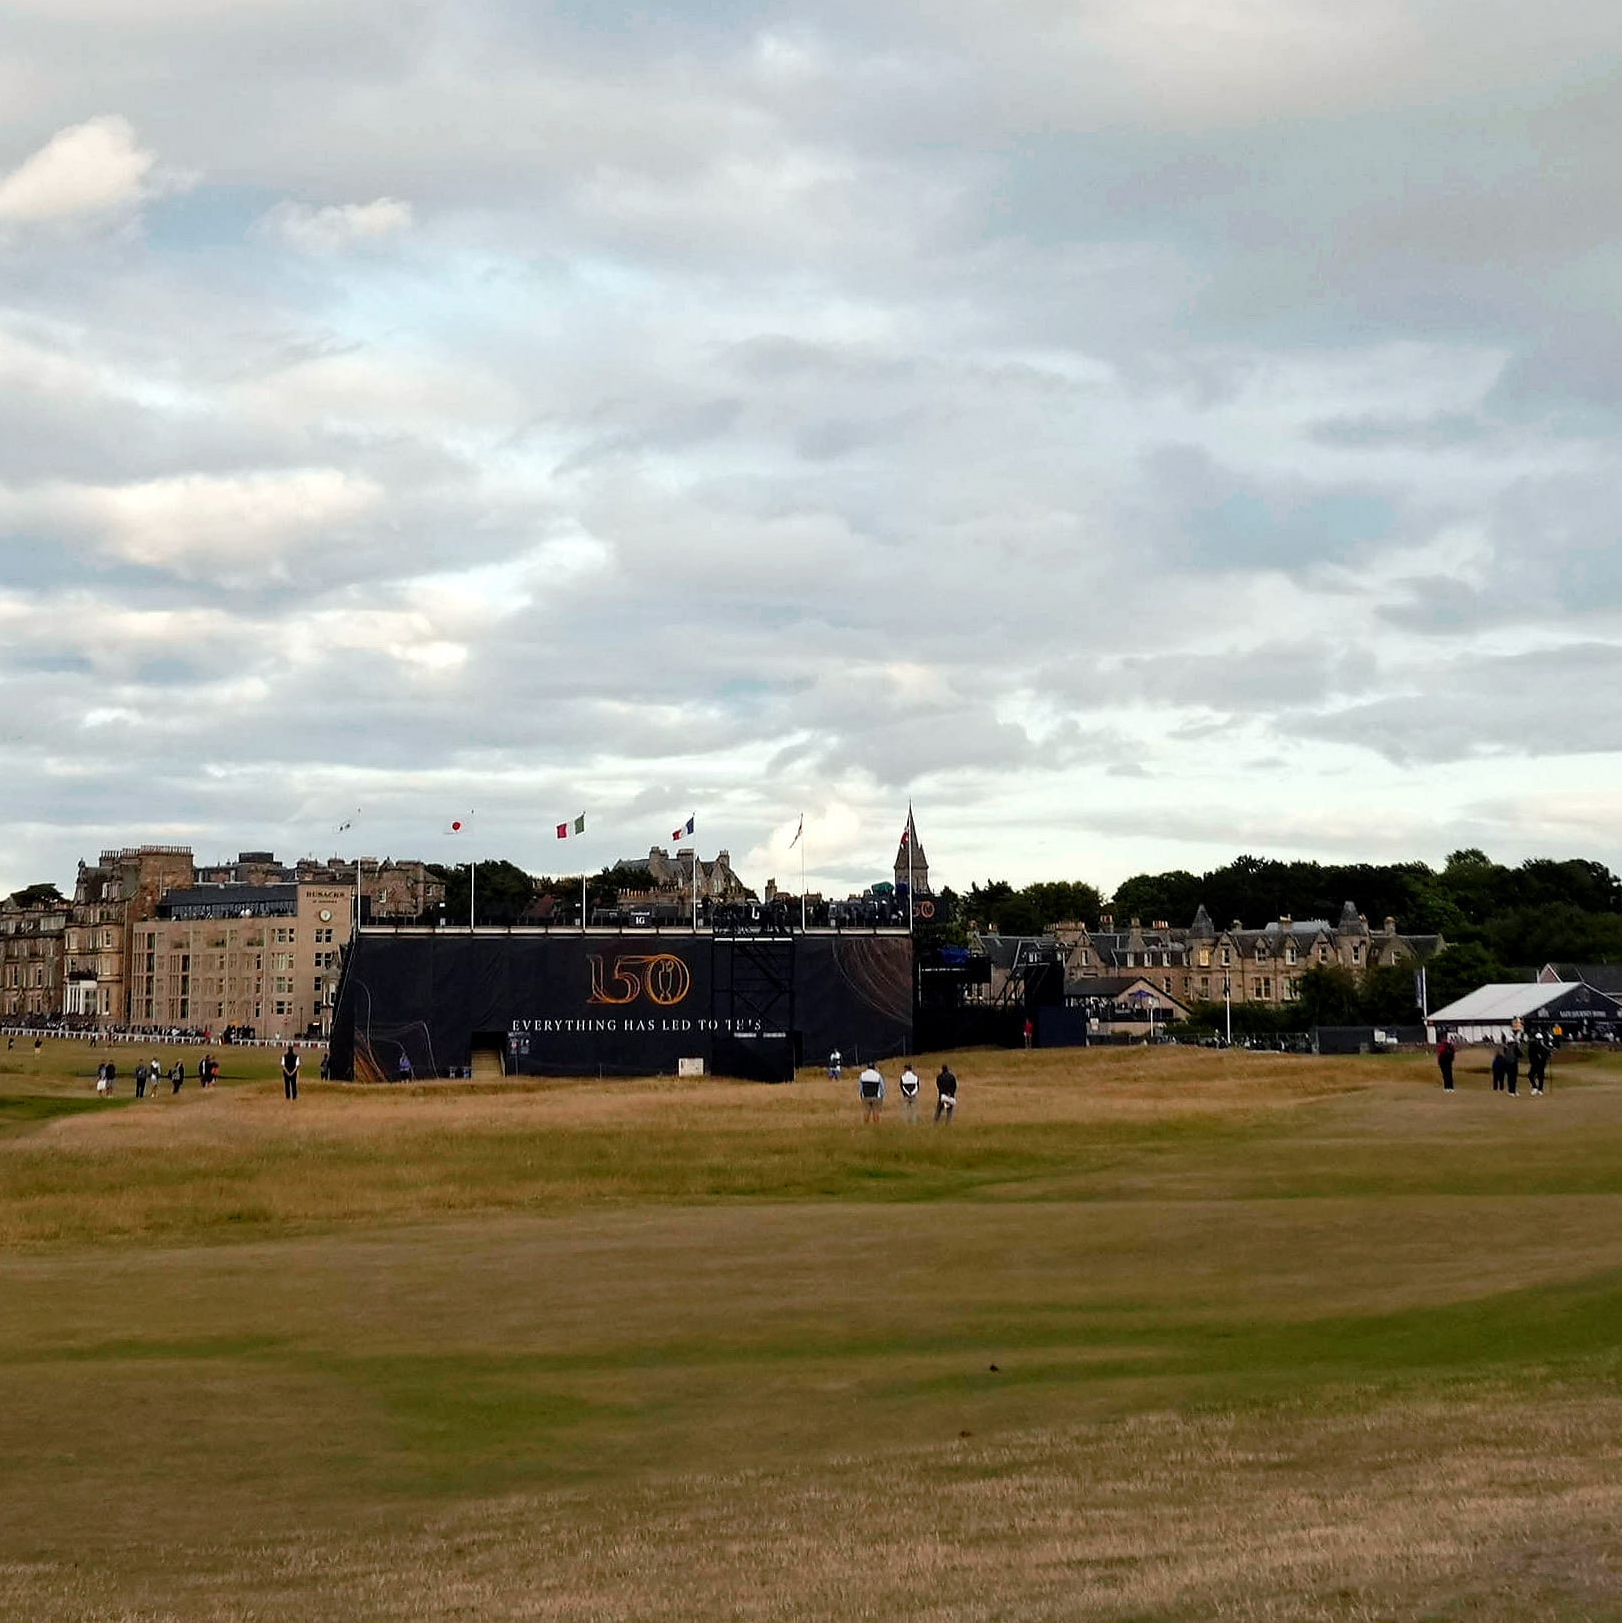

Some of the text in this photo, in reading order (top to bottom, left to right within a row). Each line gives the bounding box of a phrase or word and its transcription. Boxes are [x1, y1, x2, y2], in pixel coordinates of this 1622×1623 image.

[587, 953, 690, 1005] 150
[512, 1019, 616, 1031] EVERYTHING
[624, 1019, 655, 1031] HAS
[662, 1019, 691, 1031] LED
[698, 1019, 718, 1031] TO
